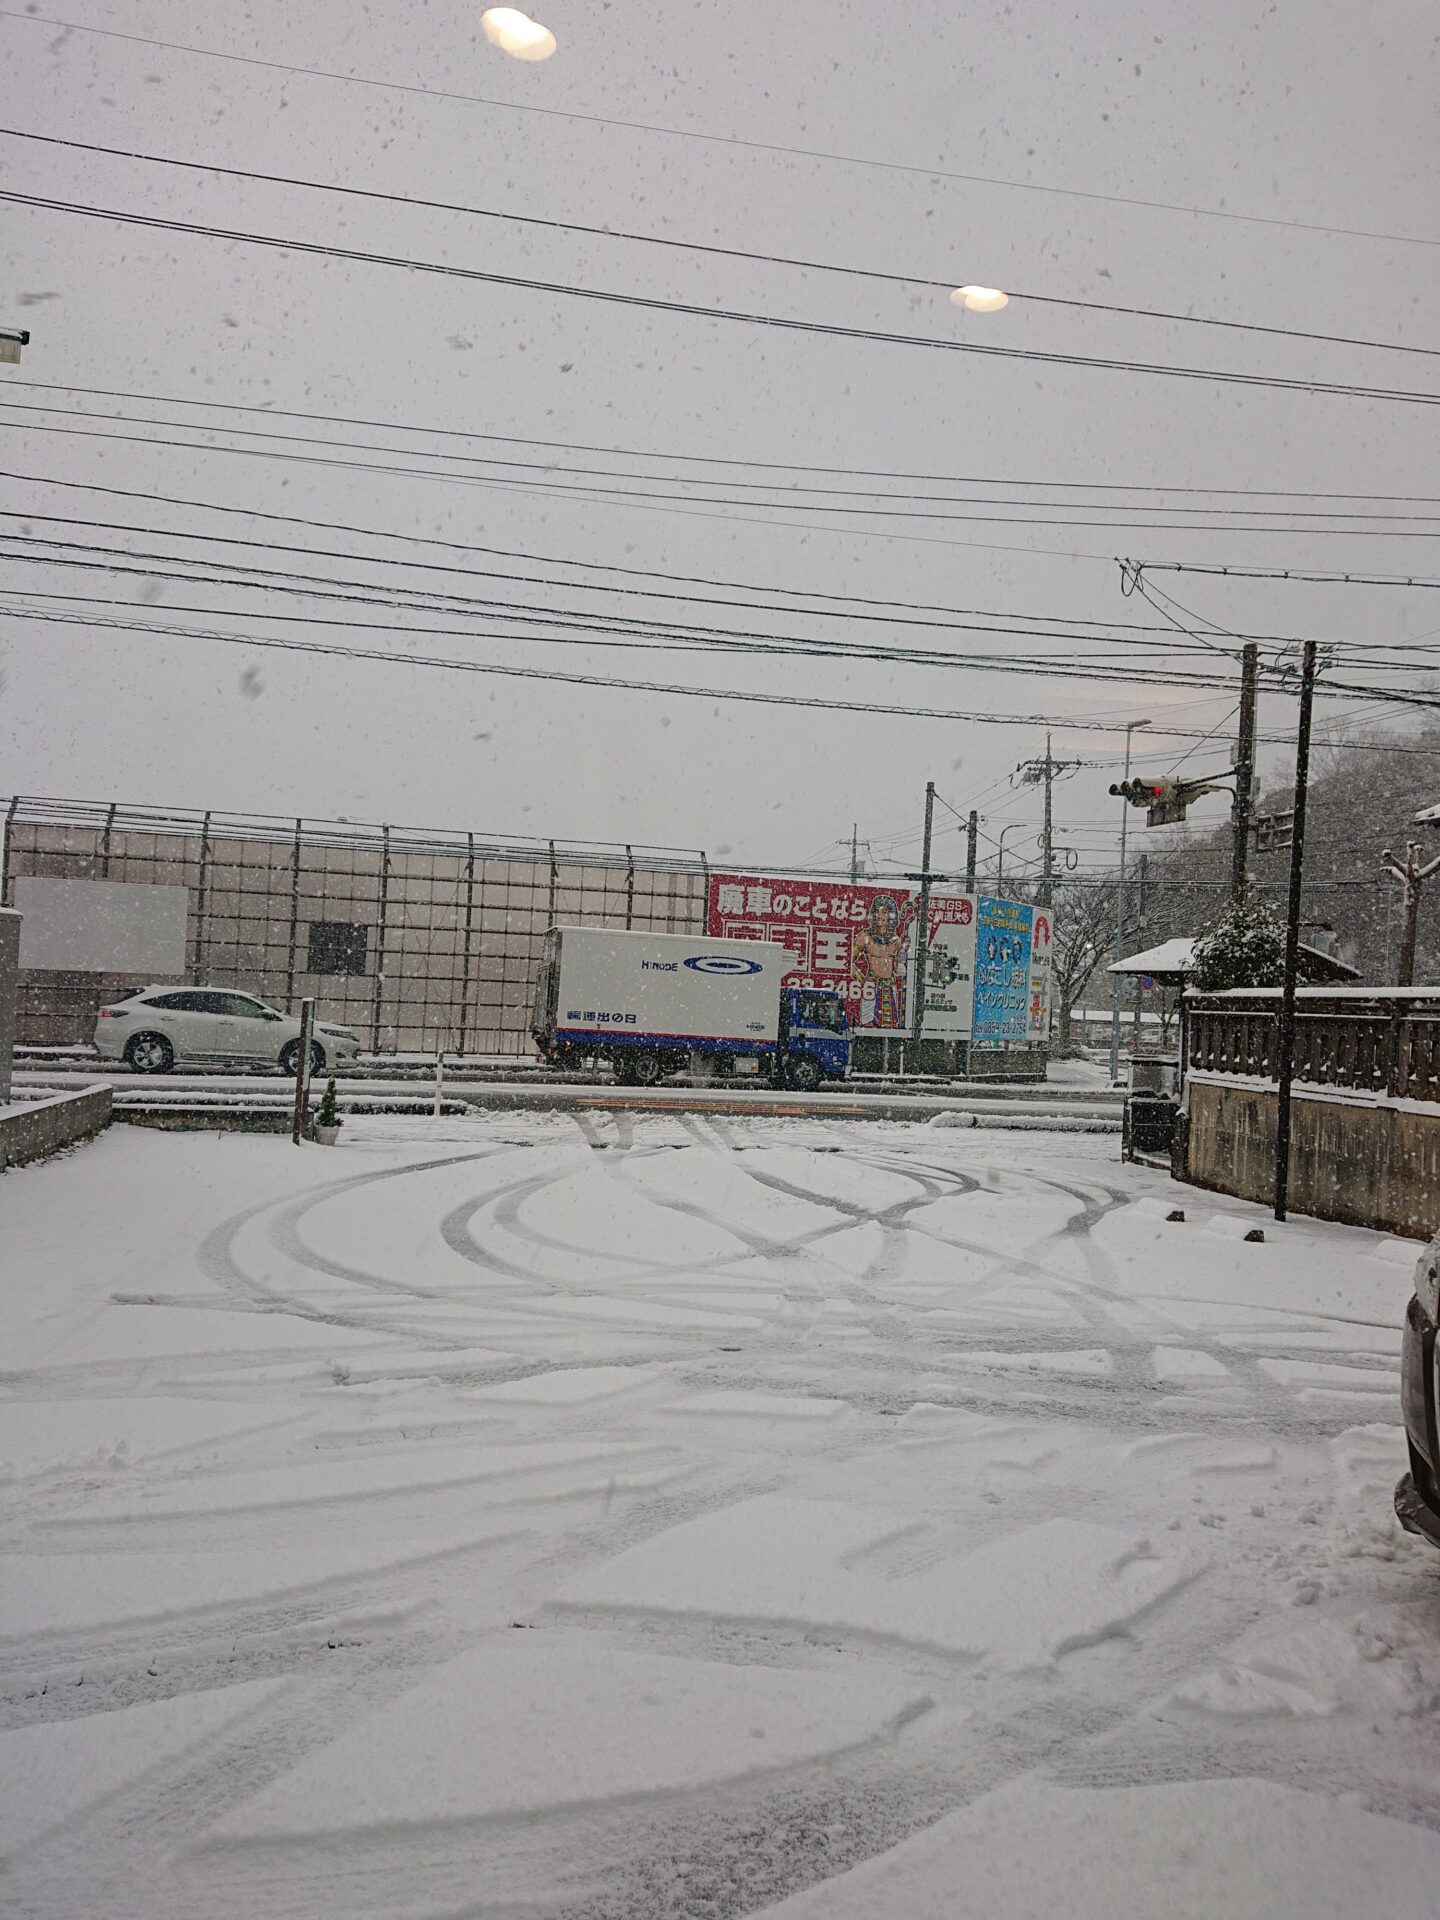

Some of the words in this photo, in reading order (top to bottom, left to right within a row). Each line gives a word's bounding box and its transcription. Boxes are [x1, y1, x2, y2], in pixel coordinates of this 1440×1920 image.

[717, 883, 867, 921] 廃車のことなら
[641, 960, 679, 972] HINODE
